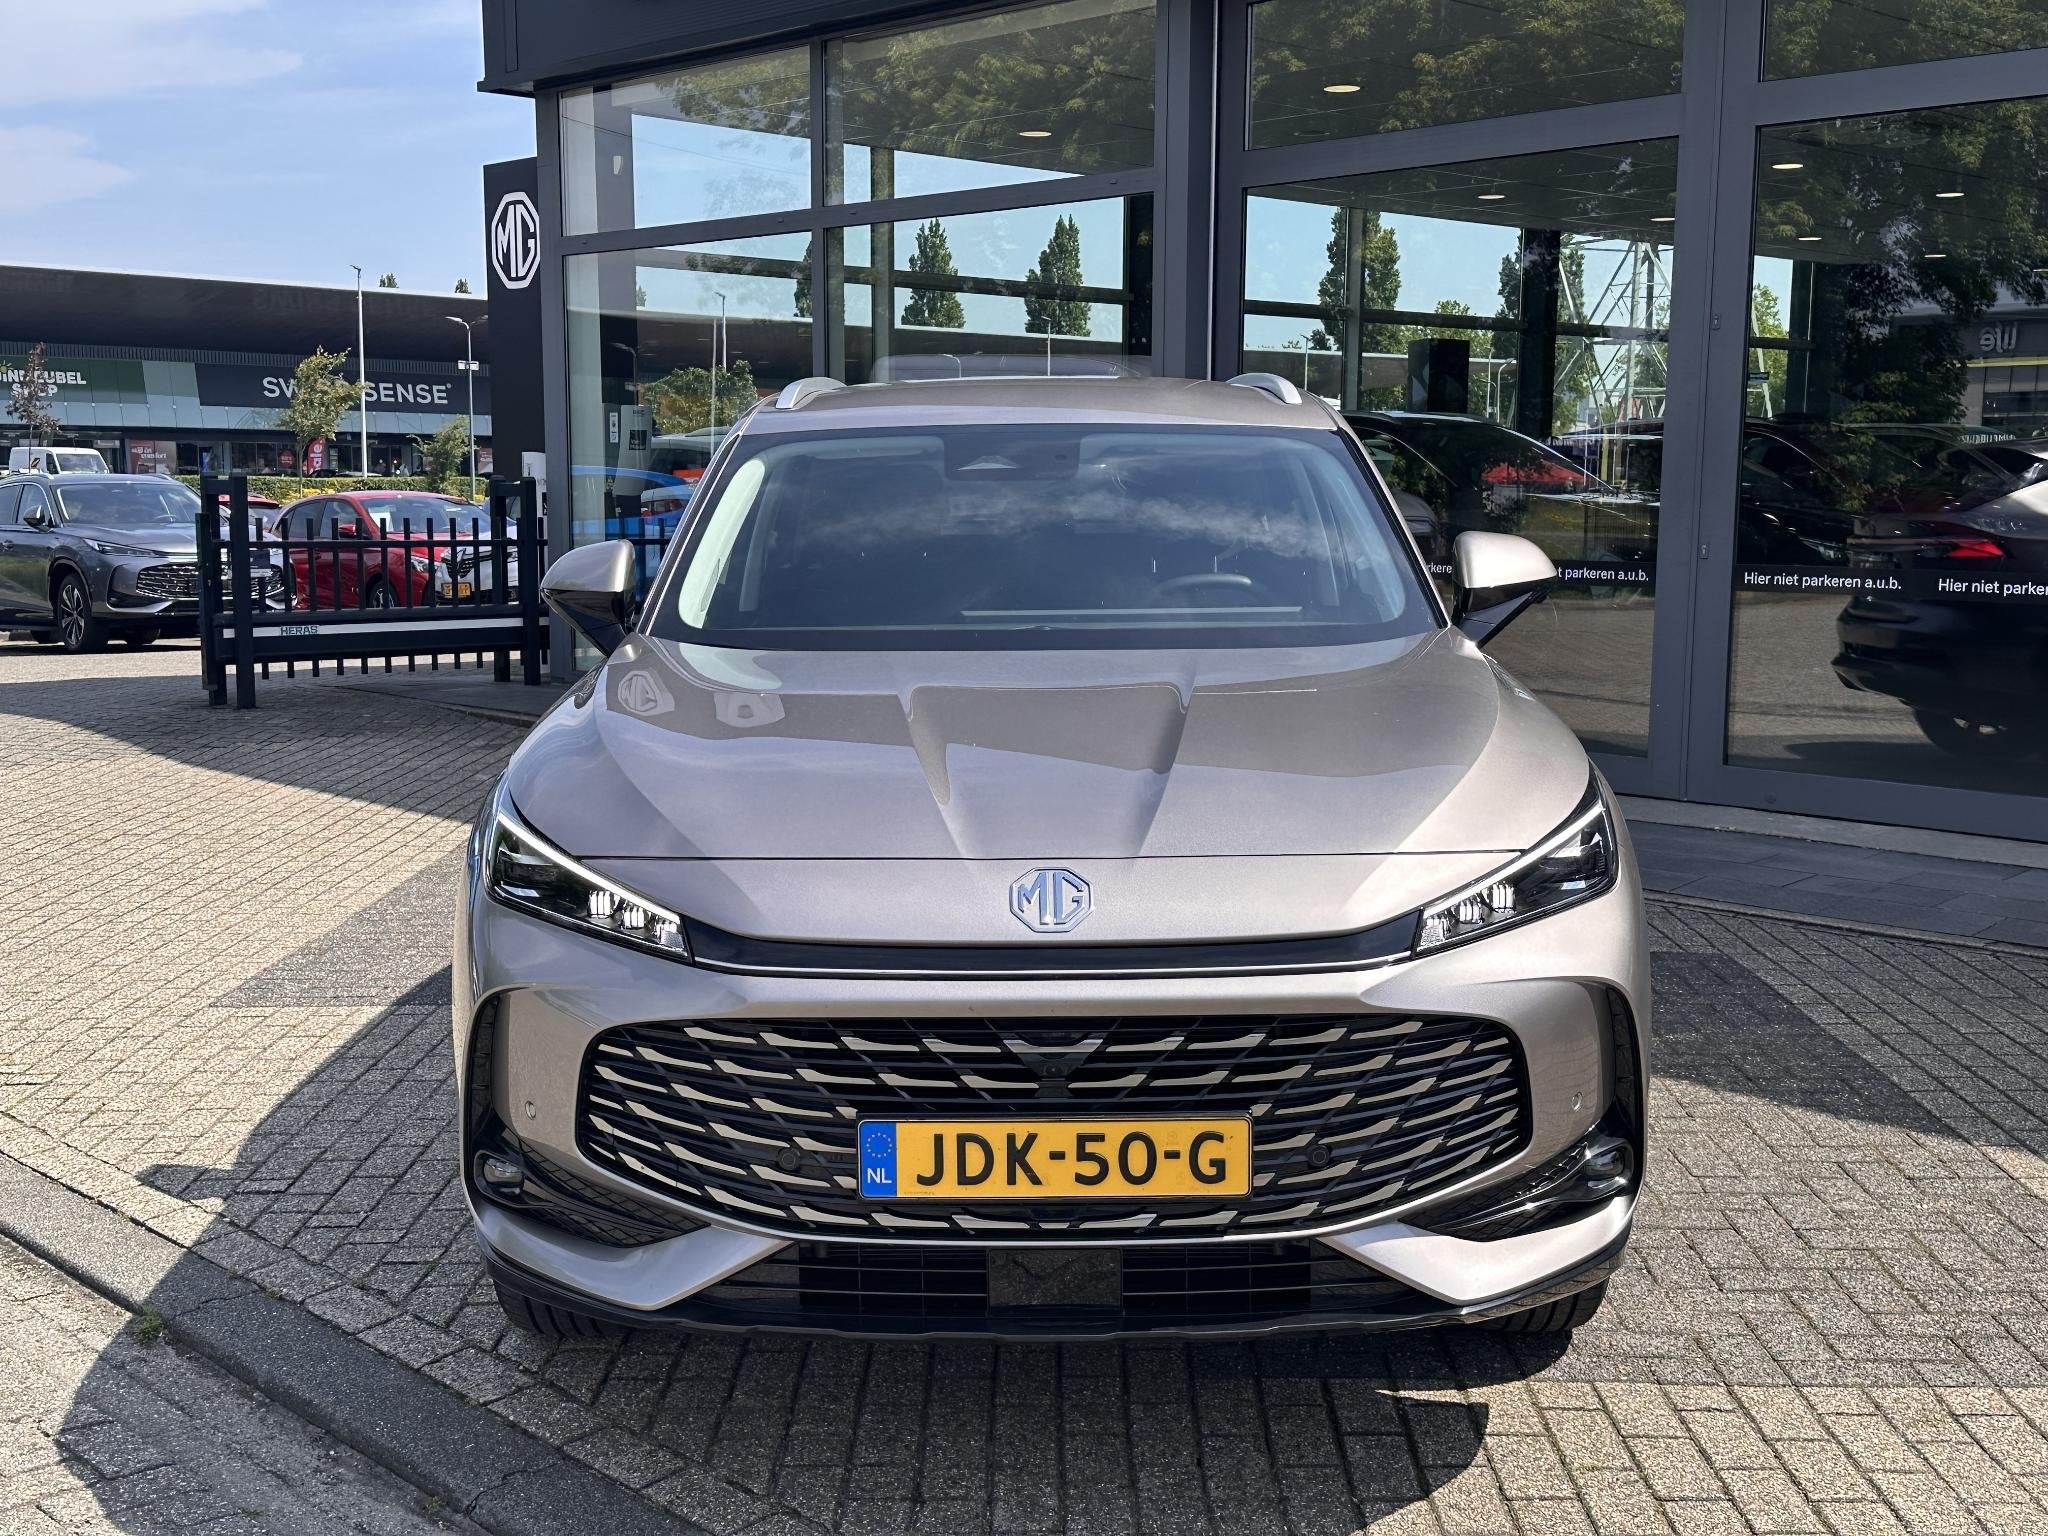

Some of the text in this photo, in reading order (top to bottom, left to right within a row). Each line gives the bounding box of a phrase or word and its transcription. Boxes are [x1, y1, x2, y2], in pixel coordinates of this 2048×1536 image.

[495, 202, 537, 280] MG
[1565, 566, 1615, 581] parkeren
[1617, 569, 1649, 581] a.u.b.
[1744, 572, 1902, 590] Hier niet parkeren a.u.b.
[1938, 578, 1969, 592] Hier
[1971, 579, 2000, 594] niet
[280, 625, 319, 636] HERAS
[1016, 870, 1086, 927] MG
[916, 1131, 1226, 1187] JDK-50-G
[866, 1167, 893, 1184] NL
